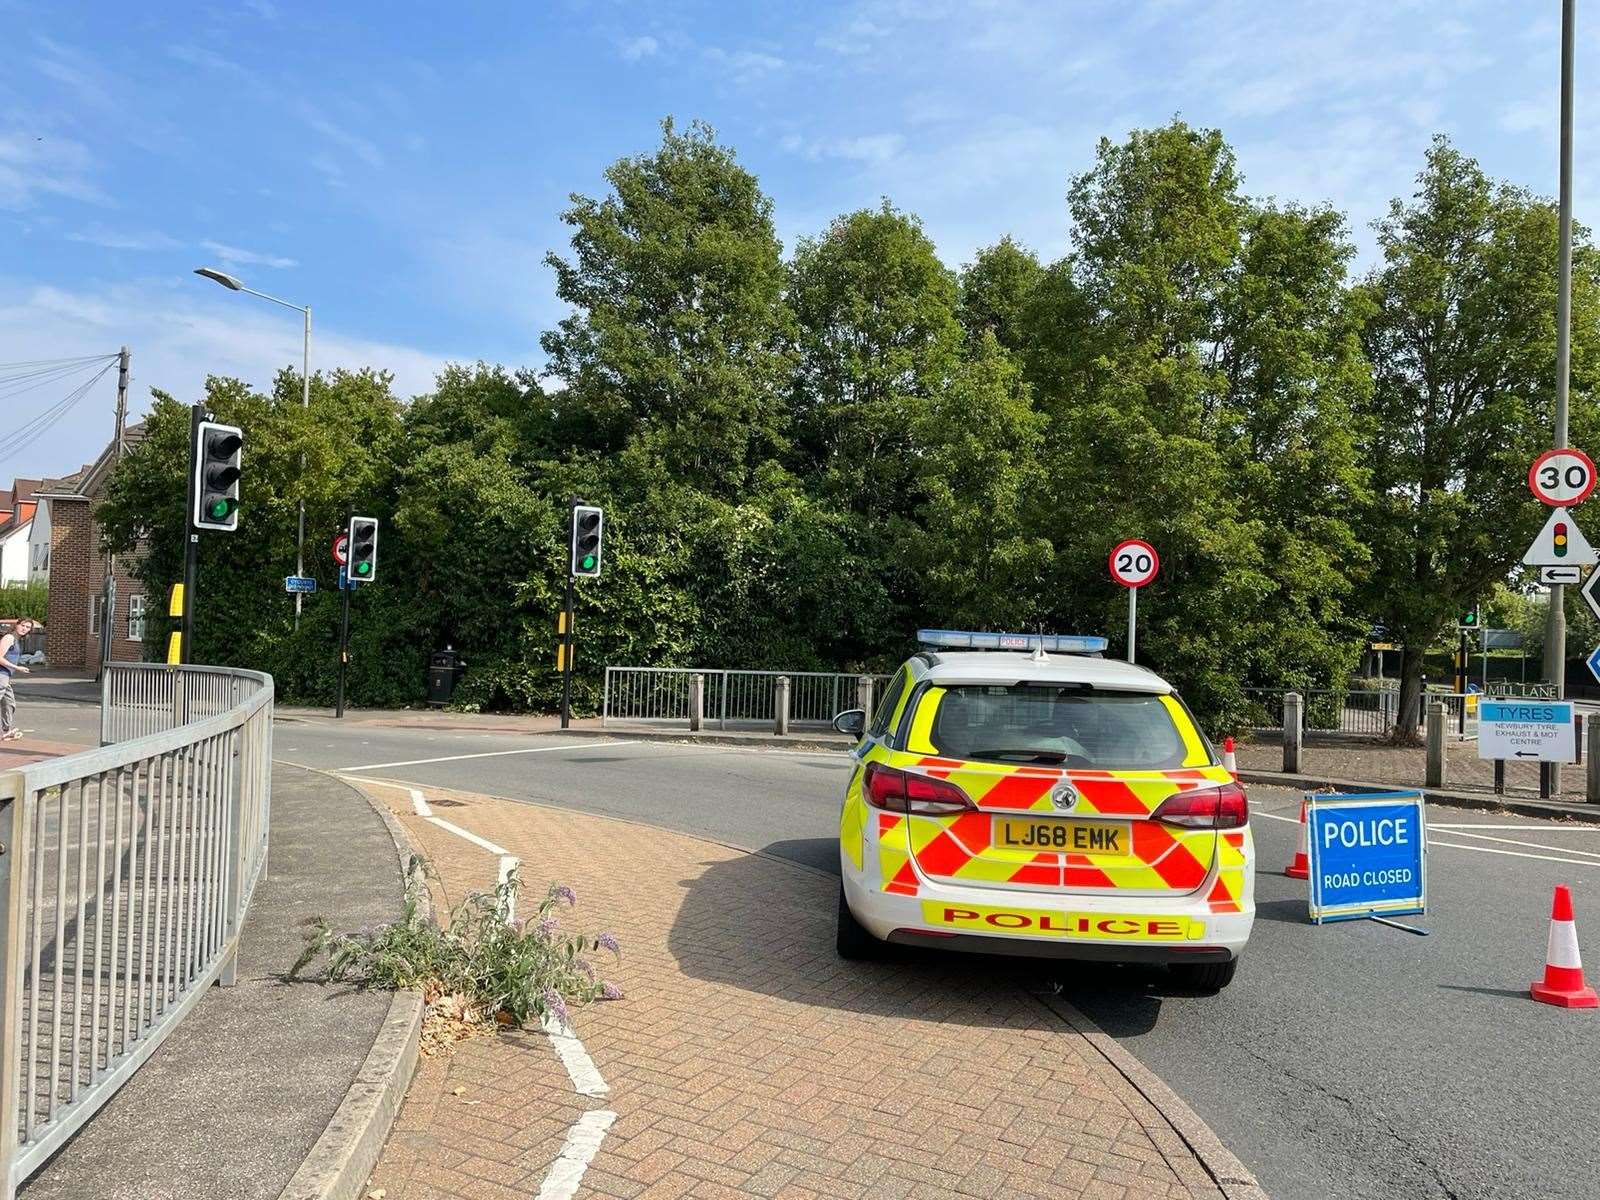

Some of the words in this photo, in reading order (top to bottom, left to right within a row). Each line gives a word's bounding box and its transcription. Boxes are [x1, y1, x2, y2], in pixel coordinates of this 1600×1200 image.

[1541, 466, 1586, 489] 30
[1118, 554, 1152, 573] 20
[1001, 637, 1025, 646] POLICE
[1488, 685, 1516, 696] MILL
[1522, 686, 1556, 698] LANE
[1497, 707, 1553, 720] TYRES
[1004, 822, 1067, 848] LJ68
[1074, 827, 1119, 851] EMK
[1325, 819, 1408, 848] POLICE
[1325, 873, 1359, 888] ROAD
[1364, 869, 1411, 885] CLOSED
[943, 908, 1183, 936] POLICE
